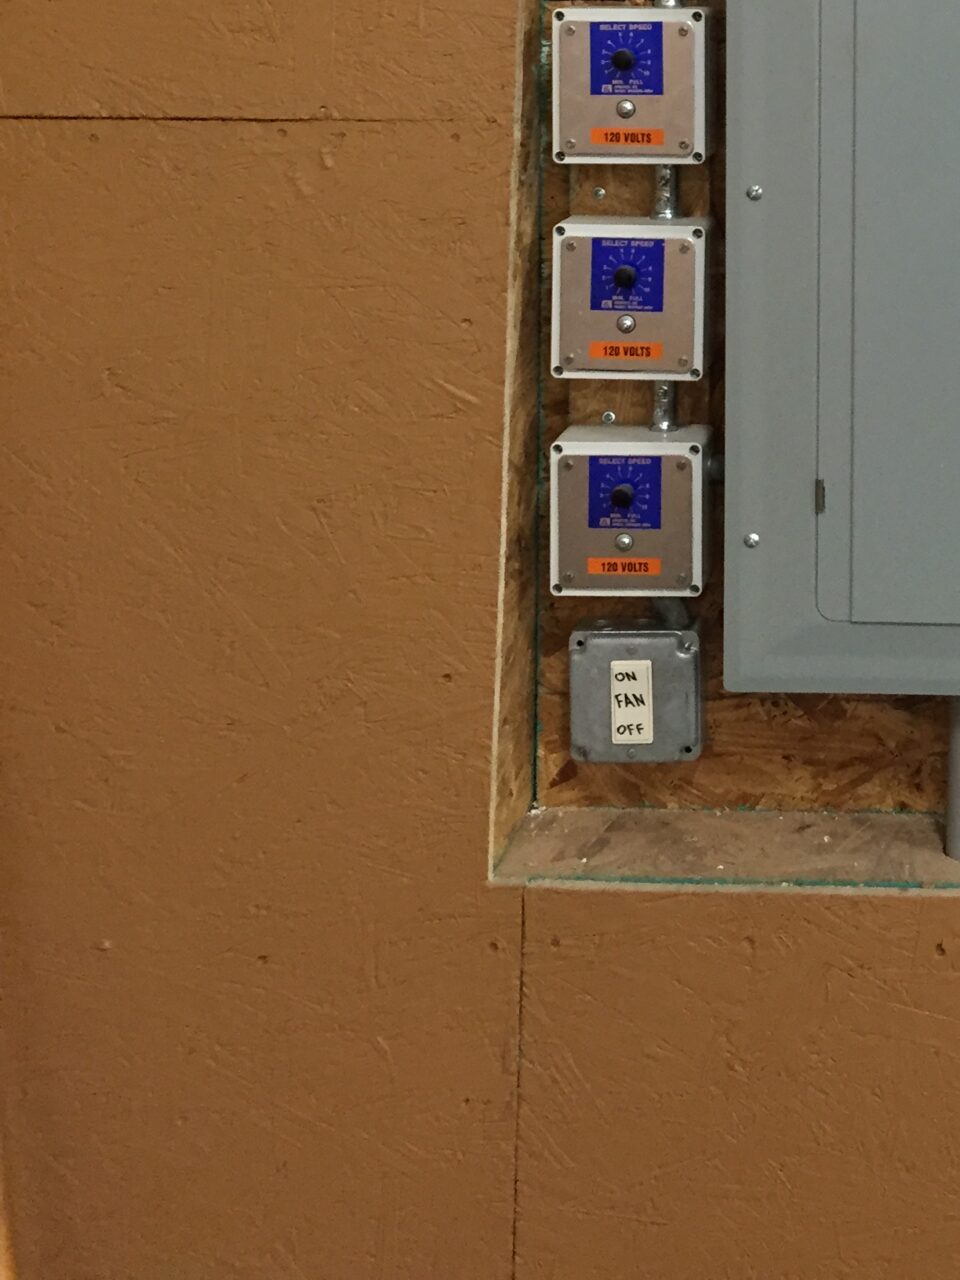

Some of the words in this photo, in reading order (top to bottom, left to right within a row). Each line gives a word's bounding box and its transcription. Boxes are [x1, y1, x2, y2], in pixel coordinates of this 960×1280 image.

[604, 132, 621, 142] 120
[624, 132, 652, 143] VOLTS
[603, 346, 619, 356] 120
[623, 346, 651, 357] VOLTS
[601, 562, 618, 572] 120
[621, 562, 649, 572] VOLTS
[614, 671, 637, 682] ON
[614, 693, 646, 708] FAN
[616, 723, 645, 735] OFF
